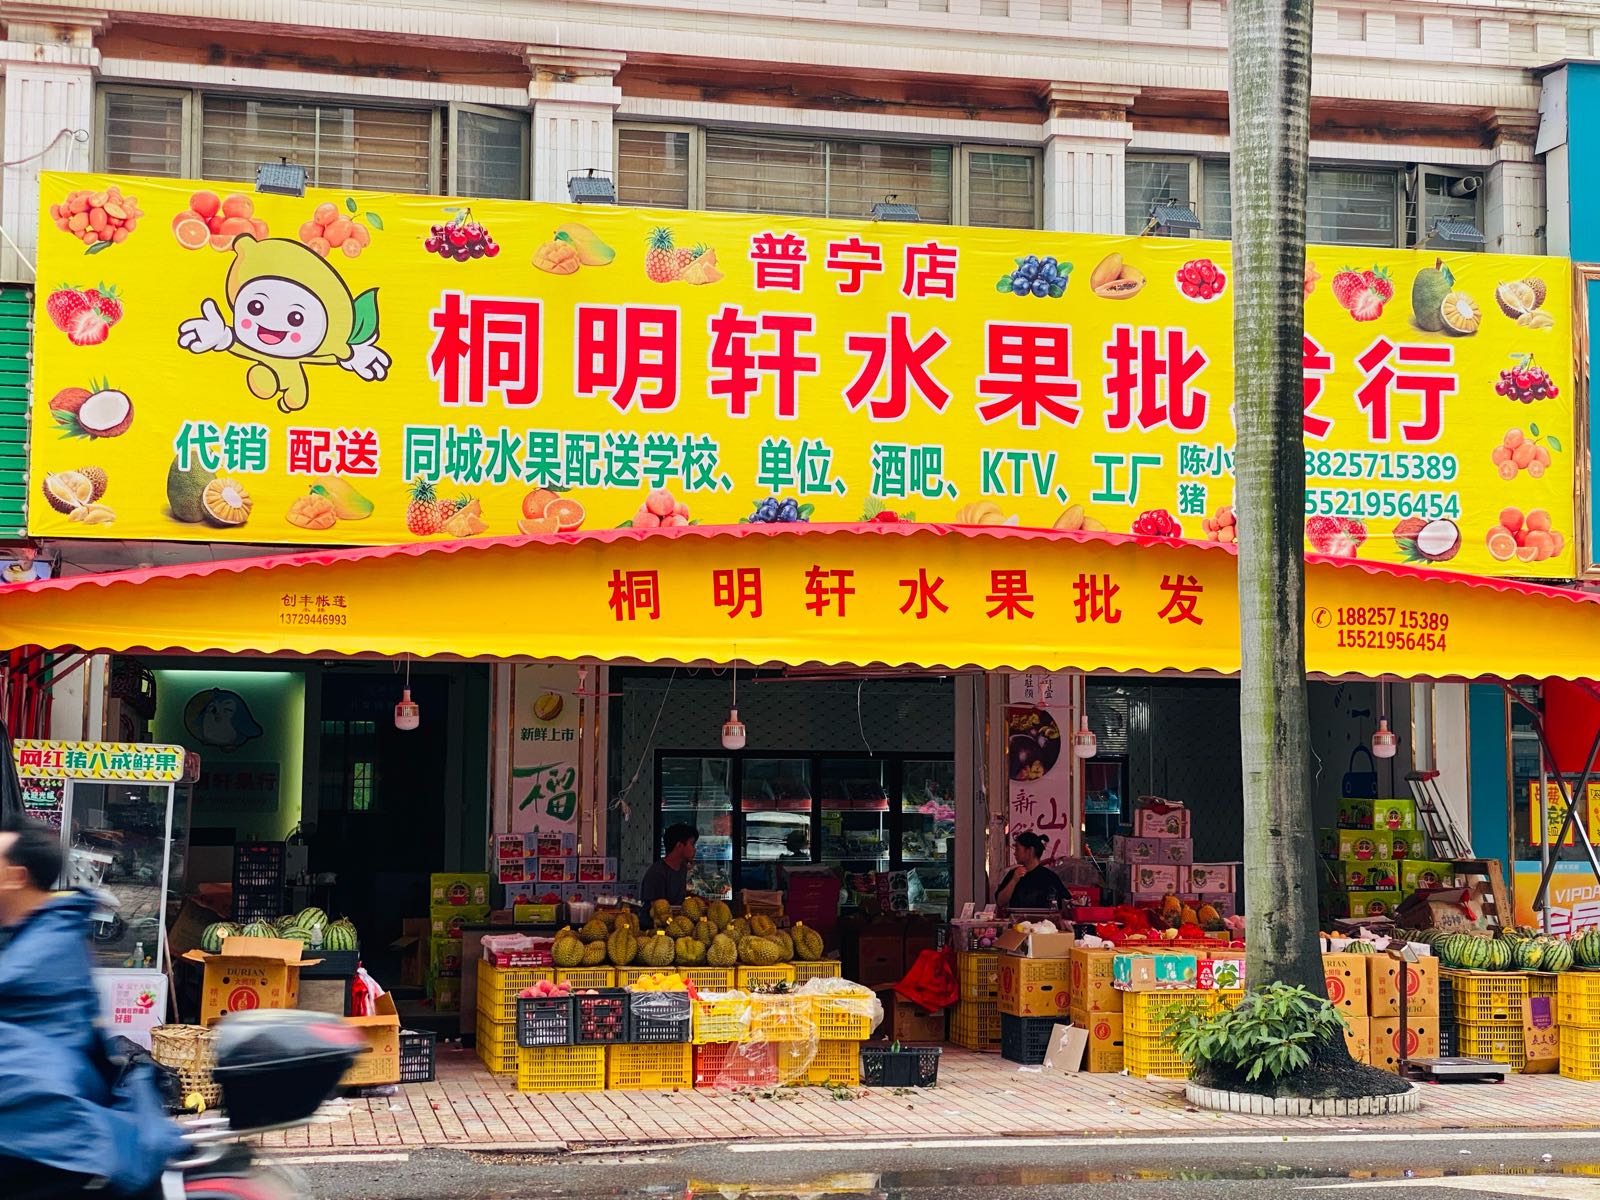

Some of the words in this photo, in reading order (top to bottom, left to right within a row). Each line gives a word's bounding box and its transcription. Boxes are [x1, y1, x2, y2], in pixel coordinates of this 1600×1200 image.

[751, 233, 957, 299] 普宁店
[177, 424, 267, 473] 代销
[289, 429, 378, 475] 配送
[1304, 451, 1456, 480] 8825715389
[1304, 490, 1459, 517] 5521956454
[608, 567, 1204, 625] 桐明轩水果批发
[280, 613, 347, 625] 13729446993
[1337, 629, 1447, 652] 15521956454
[521, 727, 574, 741] 新鲜上市
[20, 750, 176, 771] 网红猪八戒鲜果
[513, 761, 577, 832] 榴
[227, 968, 266, 977] DURIAN
